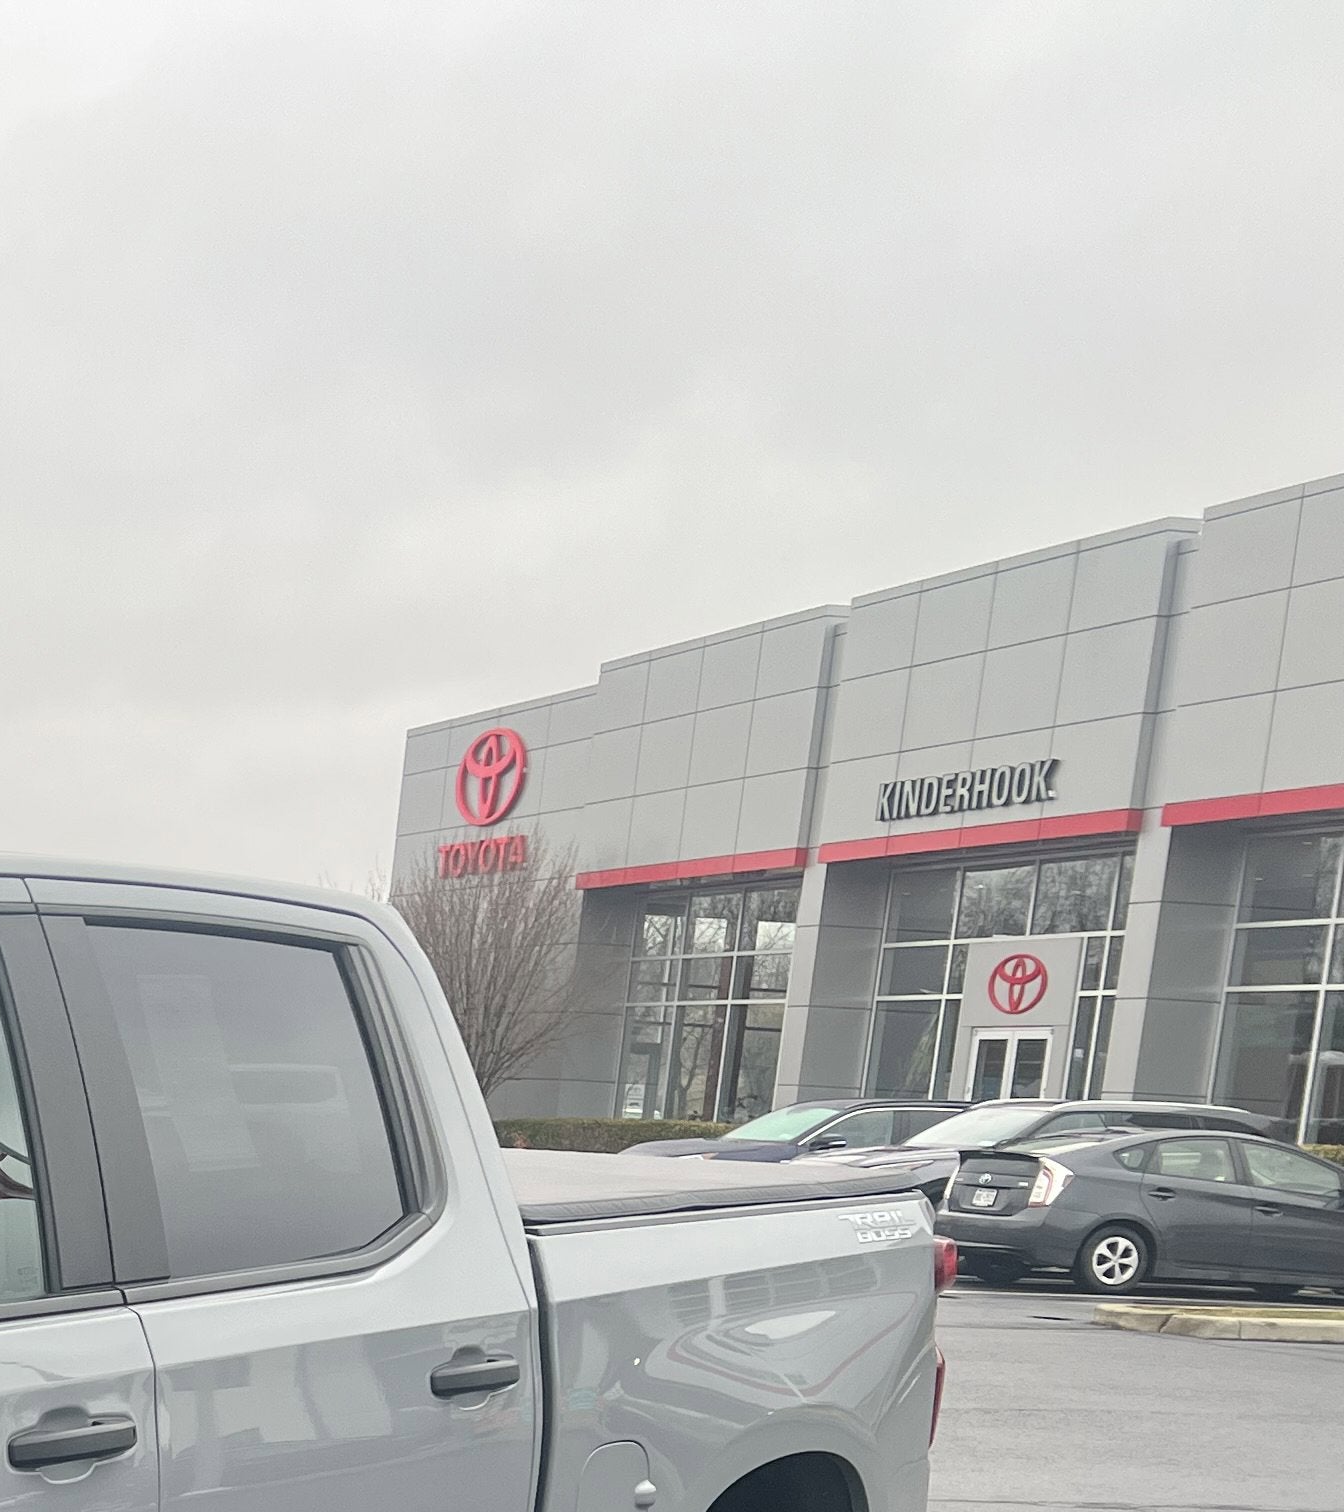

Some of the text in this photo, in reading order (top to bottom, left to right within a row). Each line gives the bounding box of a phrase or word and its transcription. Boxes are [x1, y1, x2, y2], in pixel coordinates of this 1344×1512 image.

[875, 758, 1058, 822] KINDERHOOK
[438, 835, 528, 880] TOYOTA
[855, 1226, 913, 1245] BOSS
